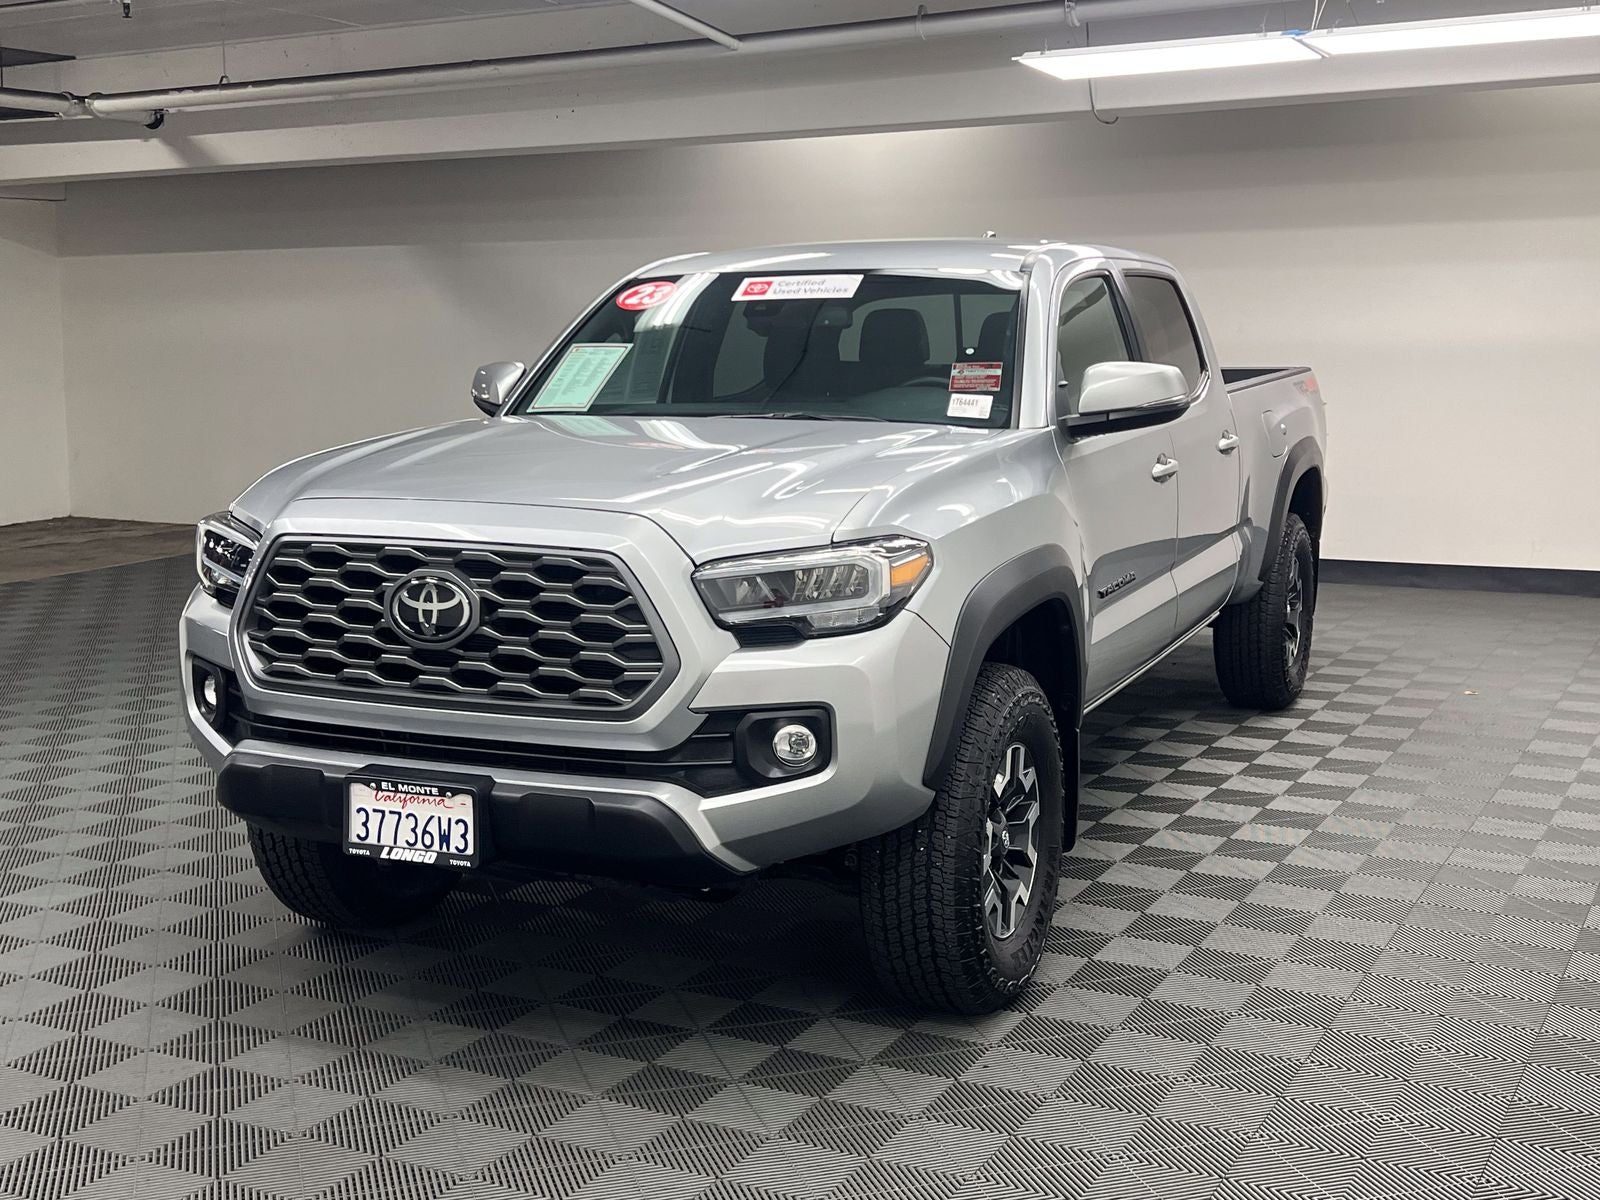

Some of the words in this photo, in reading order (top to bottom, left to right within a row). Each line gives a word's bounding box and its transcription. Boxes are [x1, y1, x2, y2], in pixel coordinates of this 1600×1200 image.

[773, 287, 802, 296] Used
[803, 286, 849, 295] Vehicles
[777, 279, 827, 288] Certified
[624, 285, 671, 304] 23
[380, 781, 396, 791] EL
[397, 783, 440, 796] MONTE
[374, 790, 454, 809] California
[355, 806, 469, 854] 37736W3
[348, 847, 371, 856] TOYOTA
[380, 846, 438, 864] LONGO
[449, 859, 472, 868] TOYOTA
